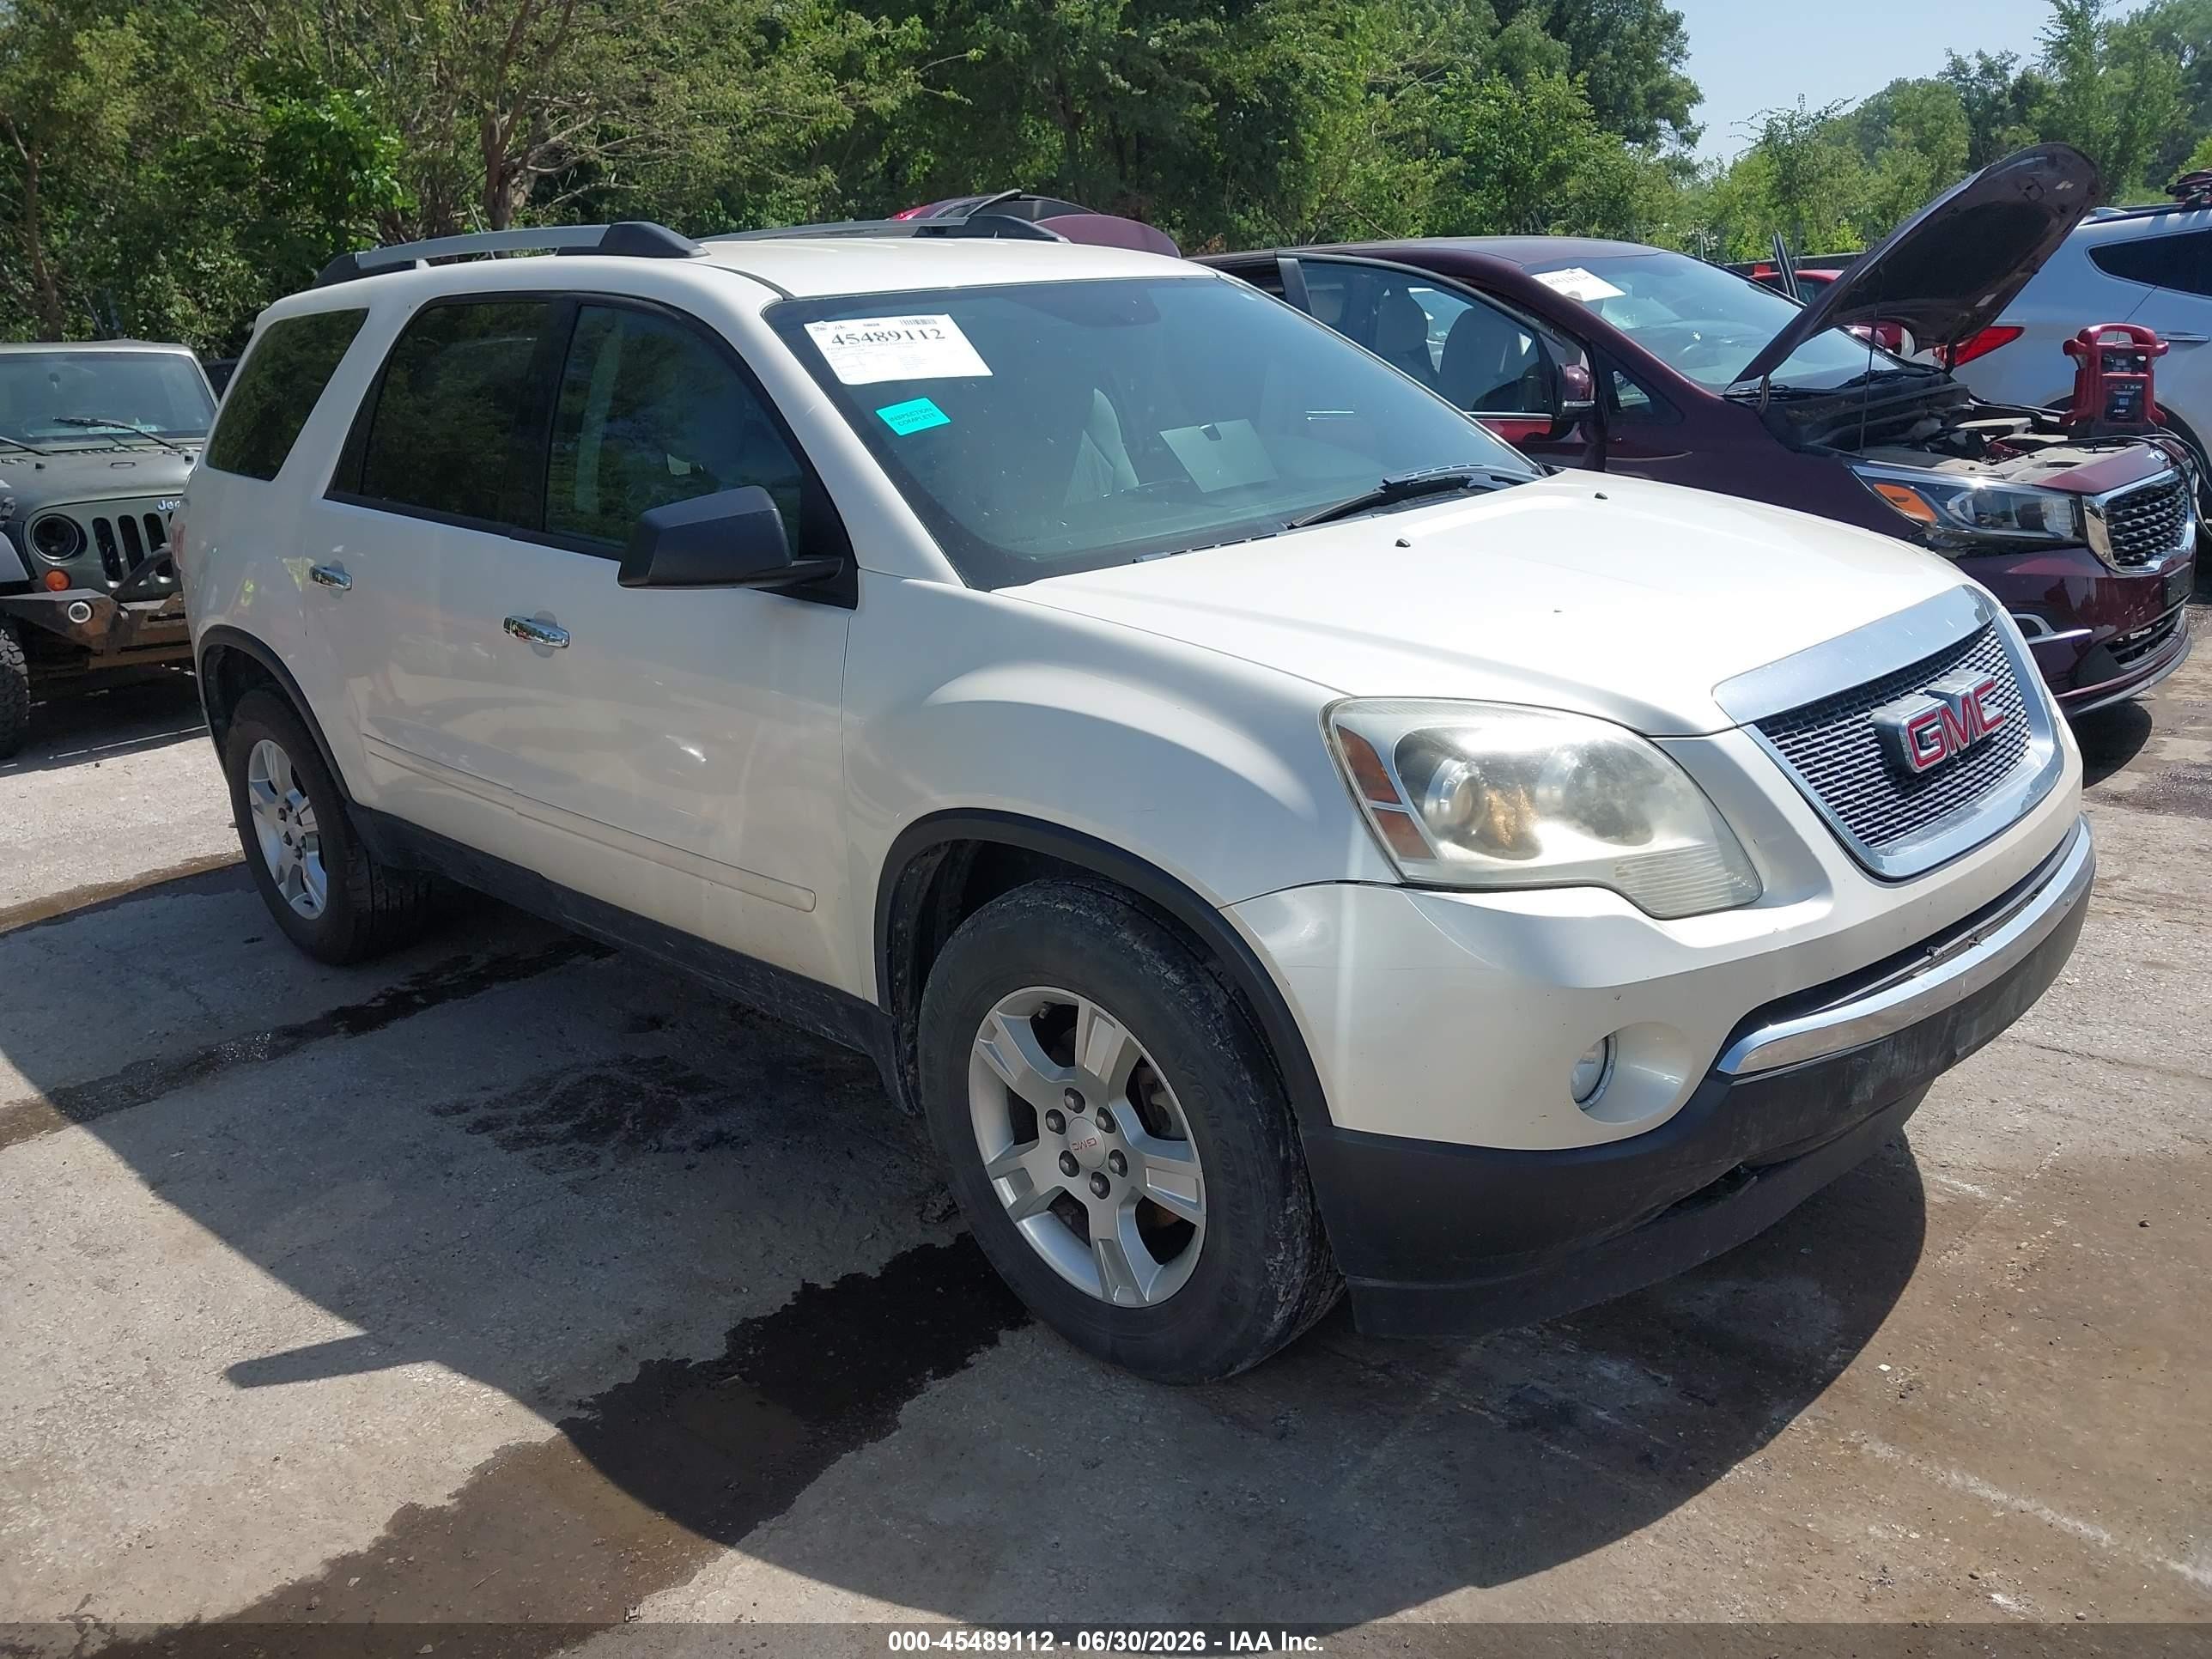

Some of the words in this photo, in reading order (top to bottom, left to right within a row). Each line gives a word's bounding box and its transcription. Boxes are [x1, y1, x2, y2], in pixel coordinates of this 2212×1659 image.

[831, 328, 946, 346] 45489112
[1905, 675, 2007, 774] GMC
[1072, 1137, 1097, 1151] GMC
